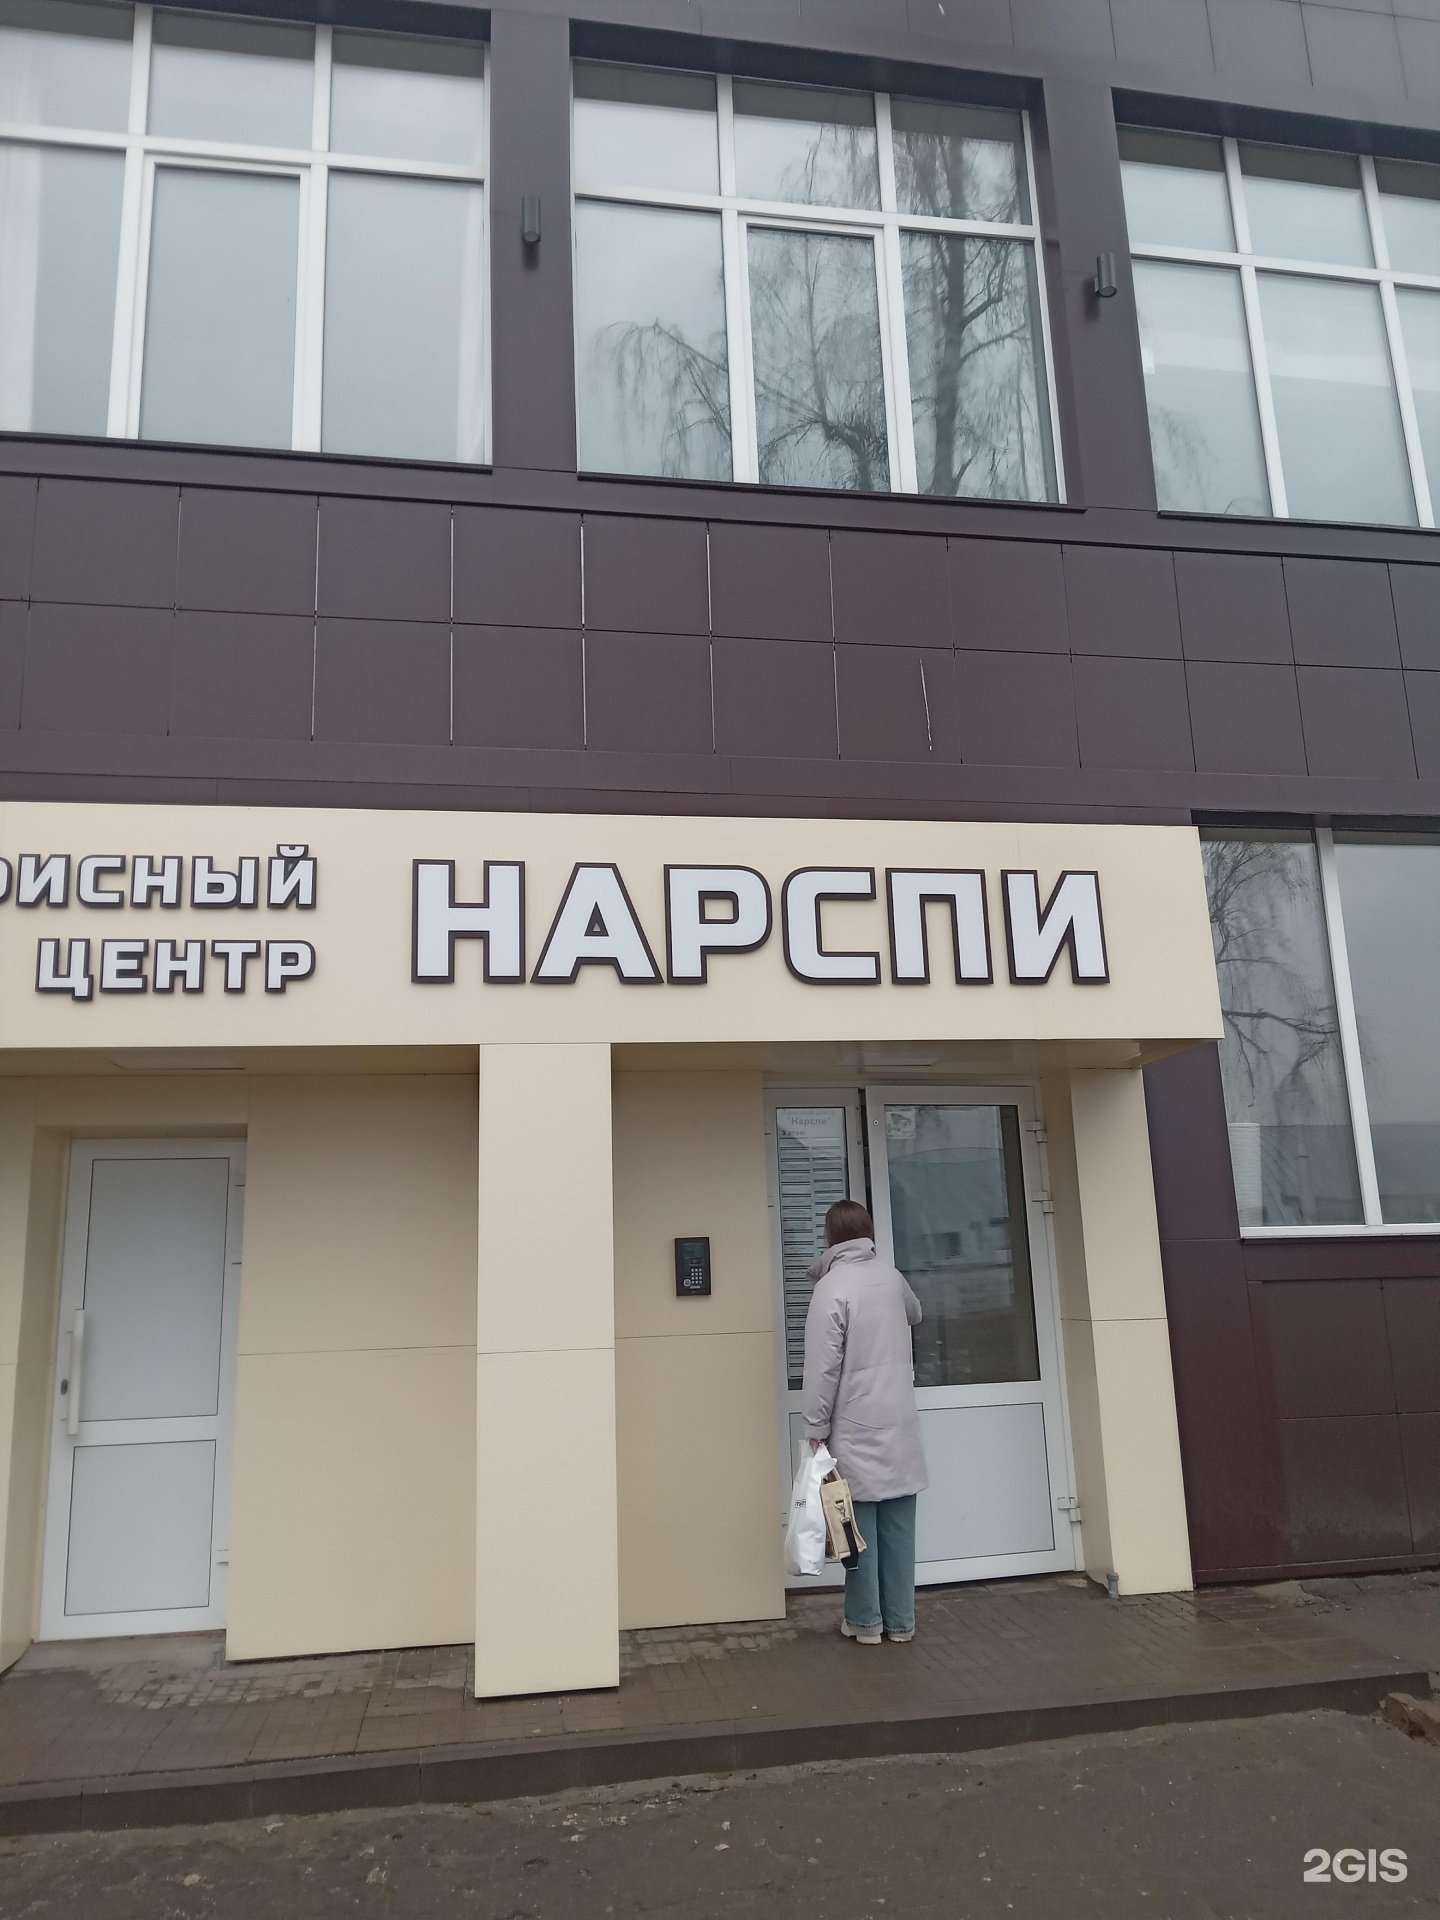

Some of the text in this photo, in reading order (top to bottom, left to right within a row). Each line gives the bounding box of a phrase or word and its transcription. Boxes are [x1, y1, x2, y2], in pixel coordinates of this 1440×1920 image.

[0, 844, 317, 909] ИСНЫЙ
[411, 859, 1110, 984] НАРСПИ
[35, 938, 316, 1001] ЦЕНТР
